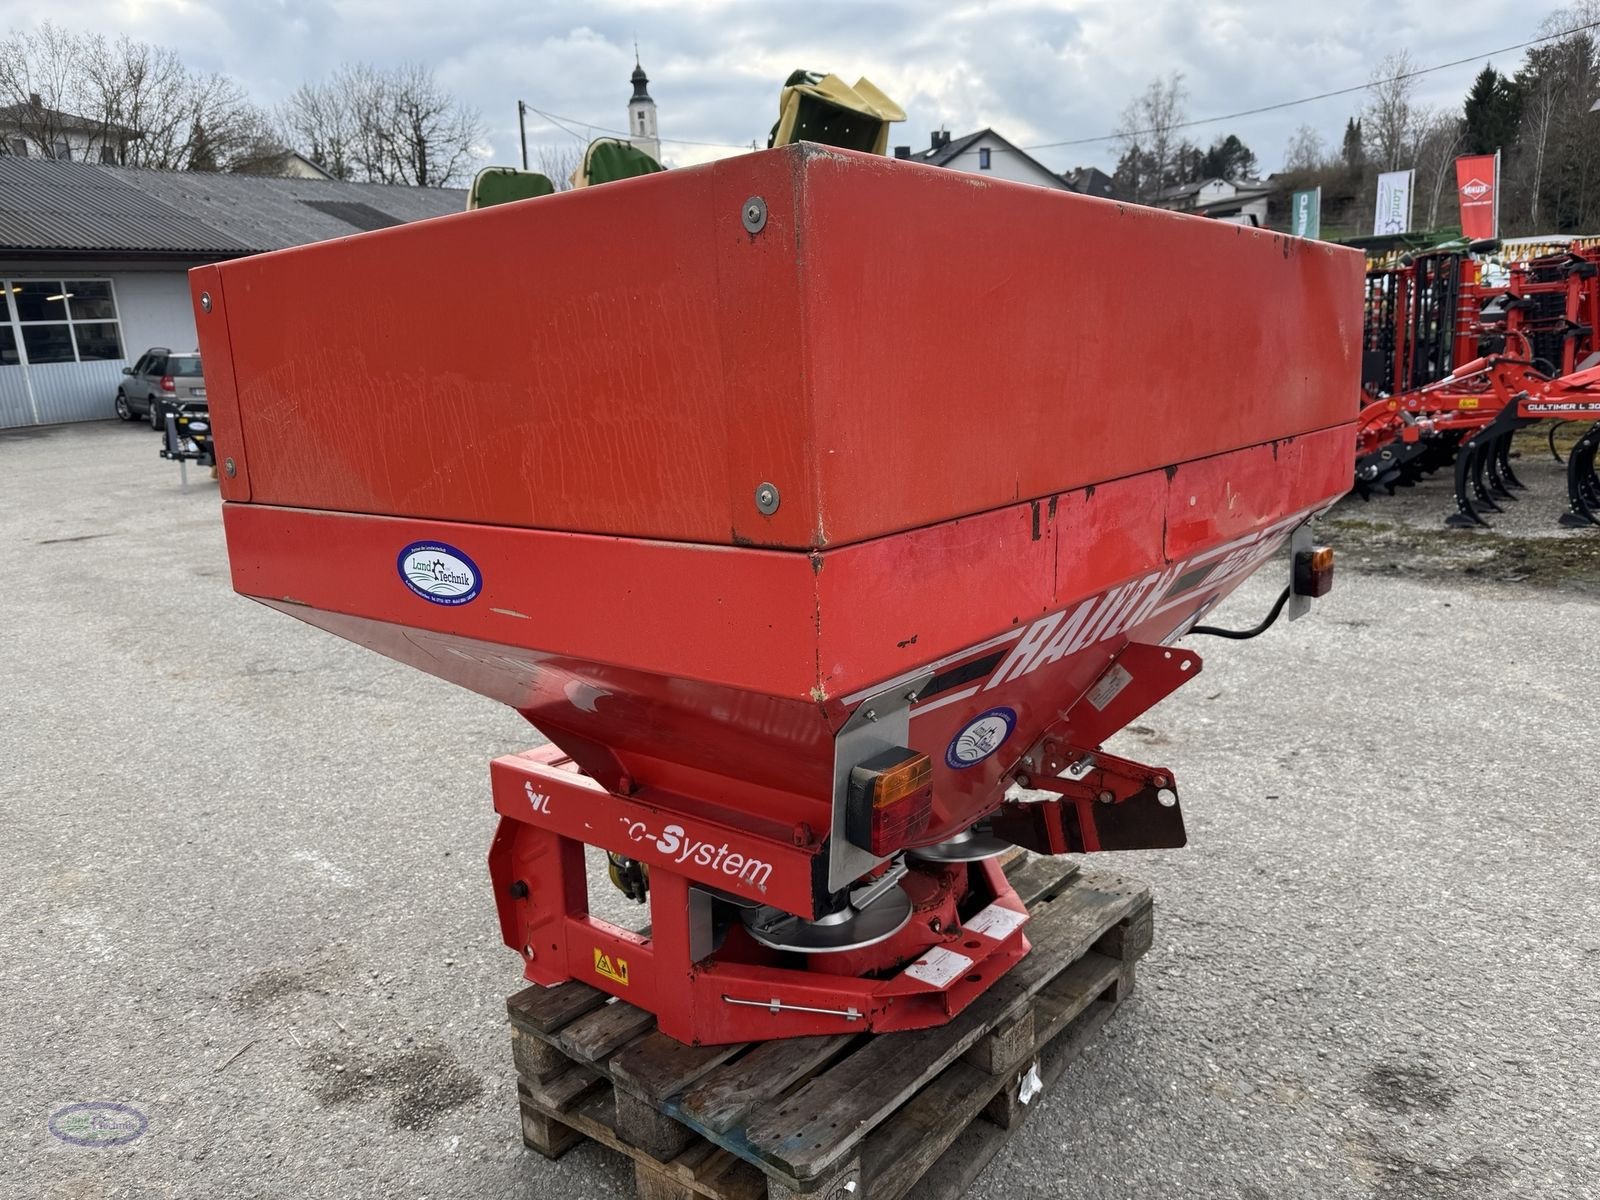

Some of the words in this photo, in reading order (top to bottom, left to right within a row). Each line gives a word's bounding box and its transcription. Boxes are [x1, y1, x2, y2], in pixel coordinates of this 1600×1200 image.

[1392, 189, 1403, 218] Land
[1527, 402, 1577, 411] CULTIMER
[412, 557, 432, 573] Land
[438, 570, 470, 586] Technik
[983, 561, 1187, 692] RAUCH
[620, 817, 773, 886] c-System
